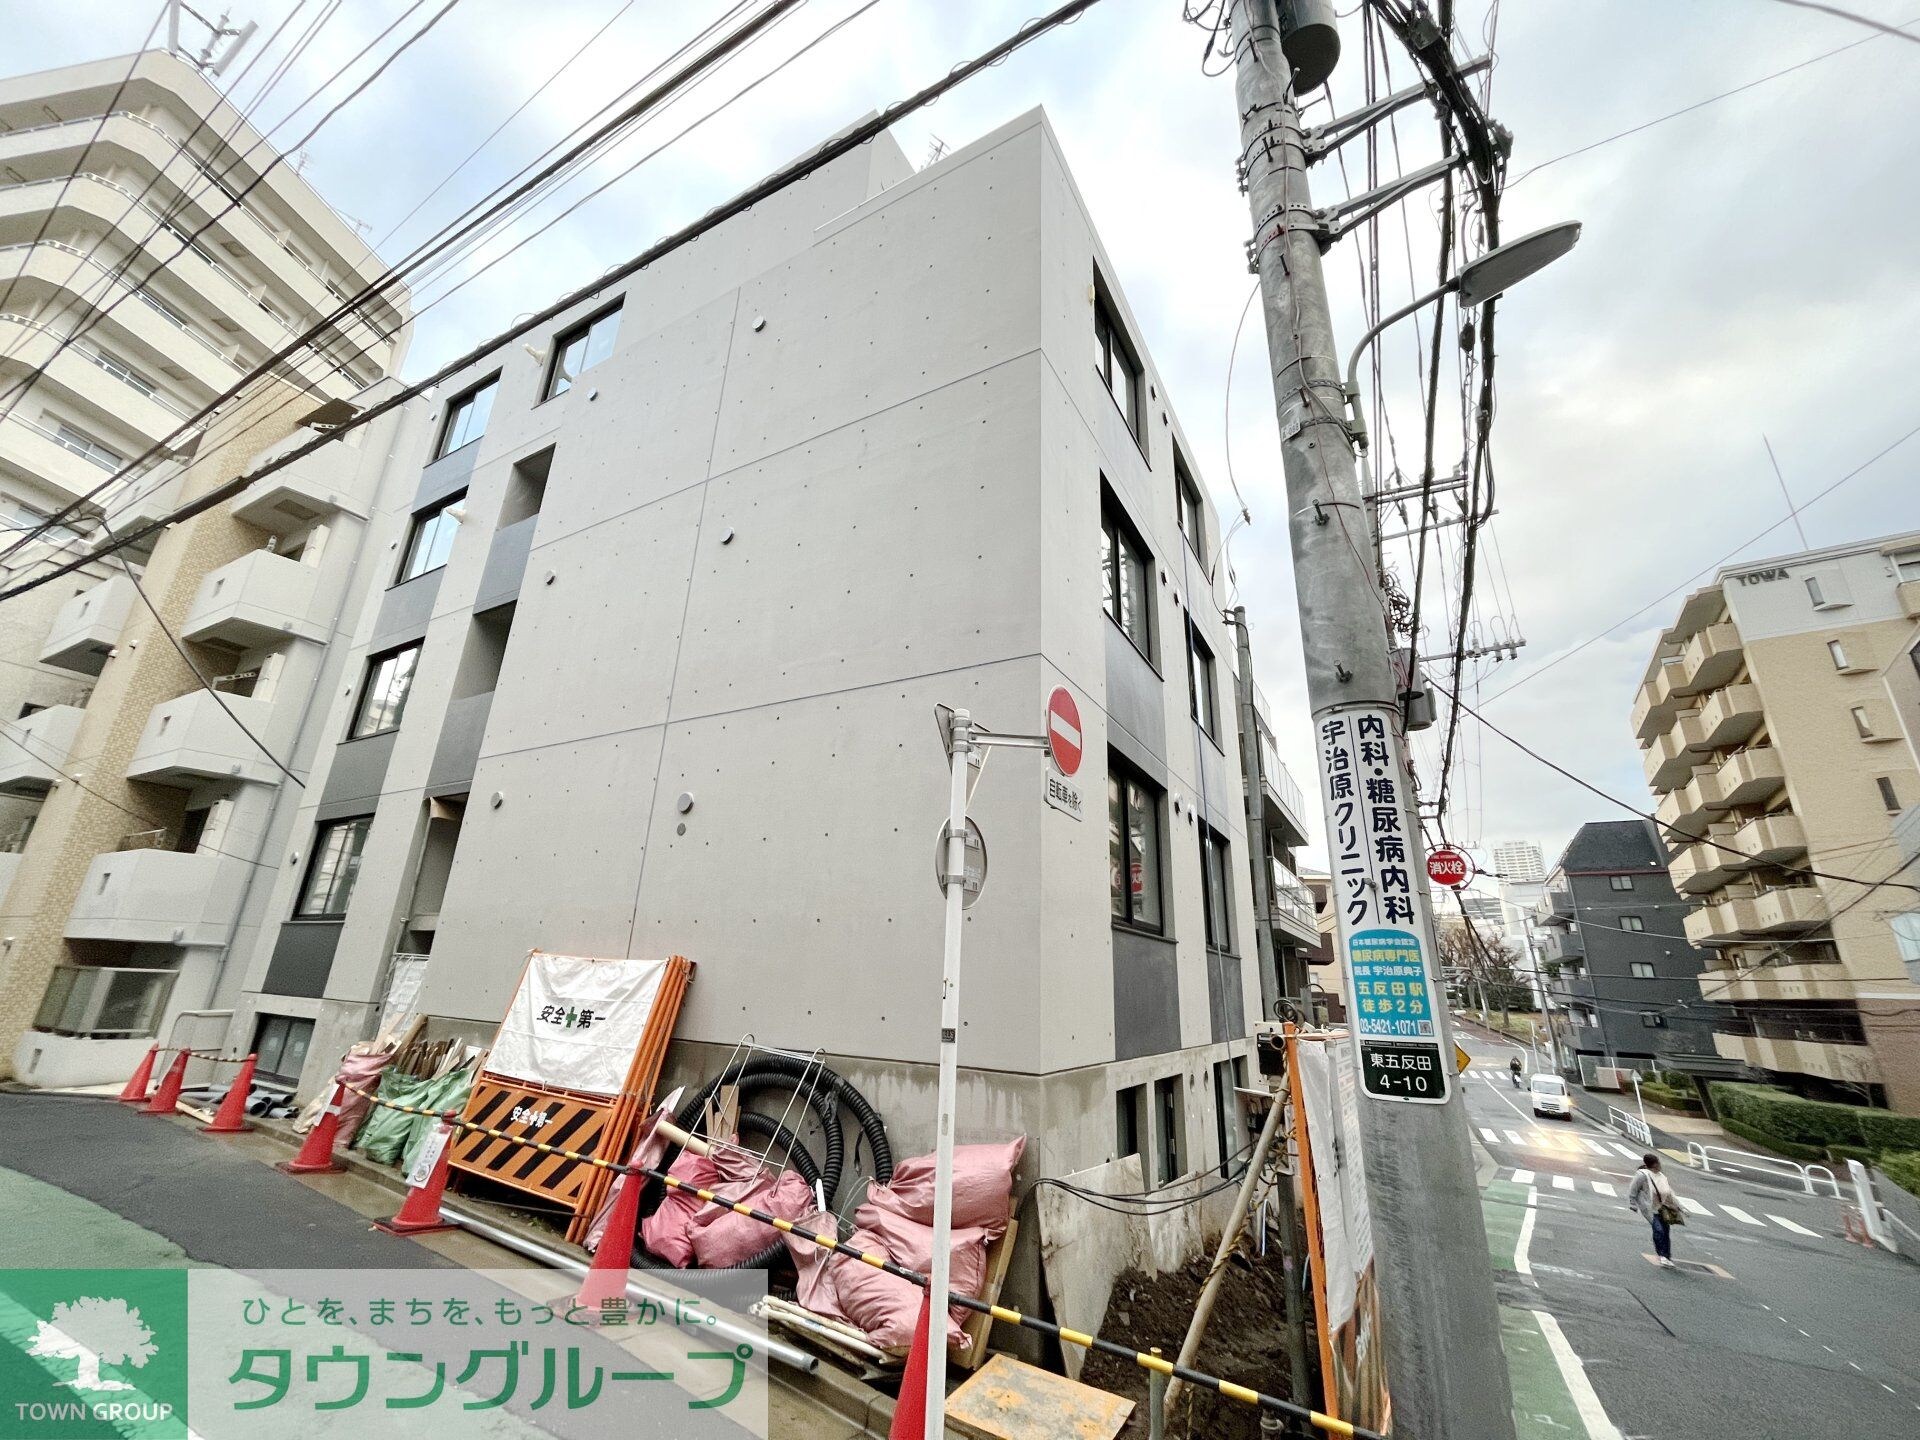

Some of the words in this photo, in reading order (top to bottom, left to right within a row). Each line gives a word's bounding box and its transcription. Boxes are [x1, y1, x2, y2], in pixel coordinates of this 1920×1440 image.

[1736, 568, 1790, 586] TOWA
[1049, 778, 1082, 813] 自転車を除く
[1322, 720, 1368, 926] 宇治原クリニック
[1357, 714, 1415, 925] 内科・糖尿病内科
[1429, 860, 1465, 875] 消火栓
[1358, 981, 1424, 997] 五反田駅
[1363, 999, 1423, 1015] 徒歩2分
[1360, 1018, 1417, 1035] 03-5421-1071
[1370, 1053, 1432, 1071] 東五反田
[1380, 1074, 1427, 1092] 4-10
